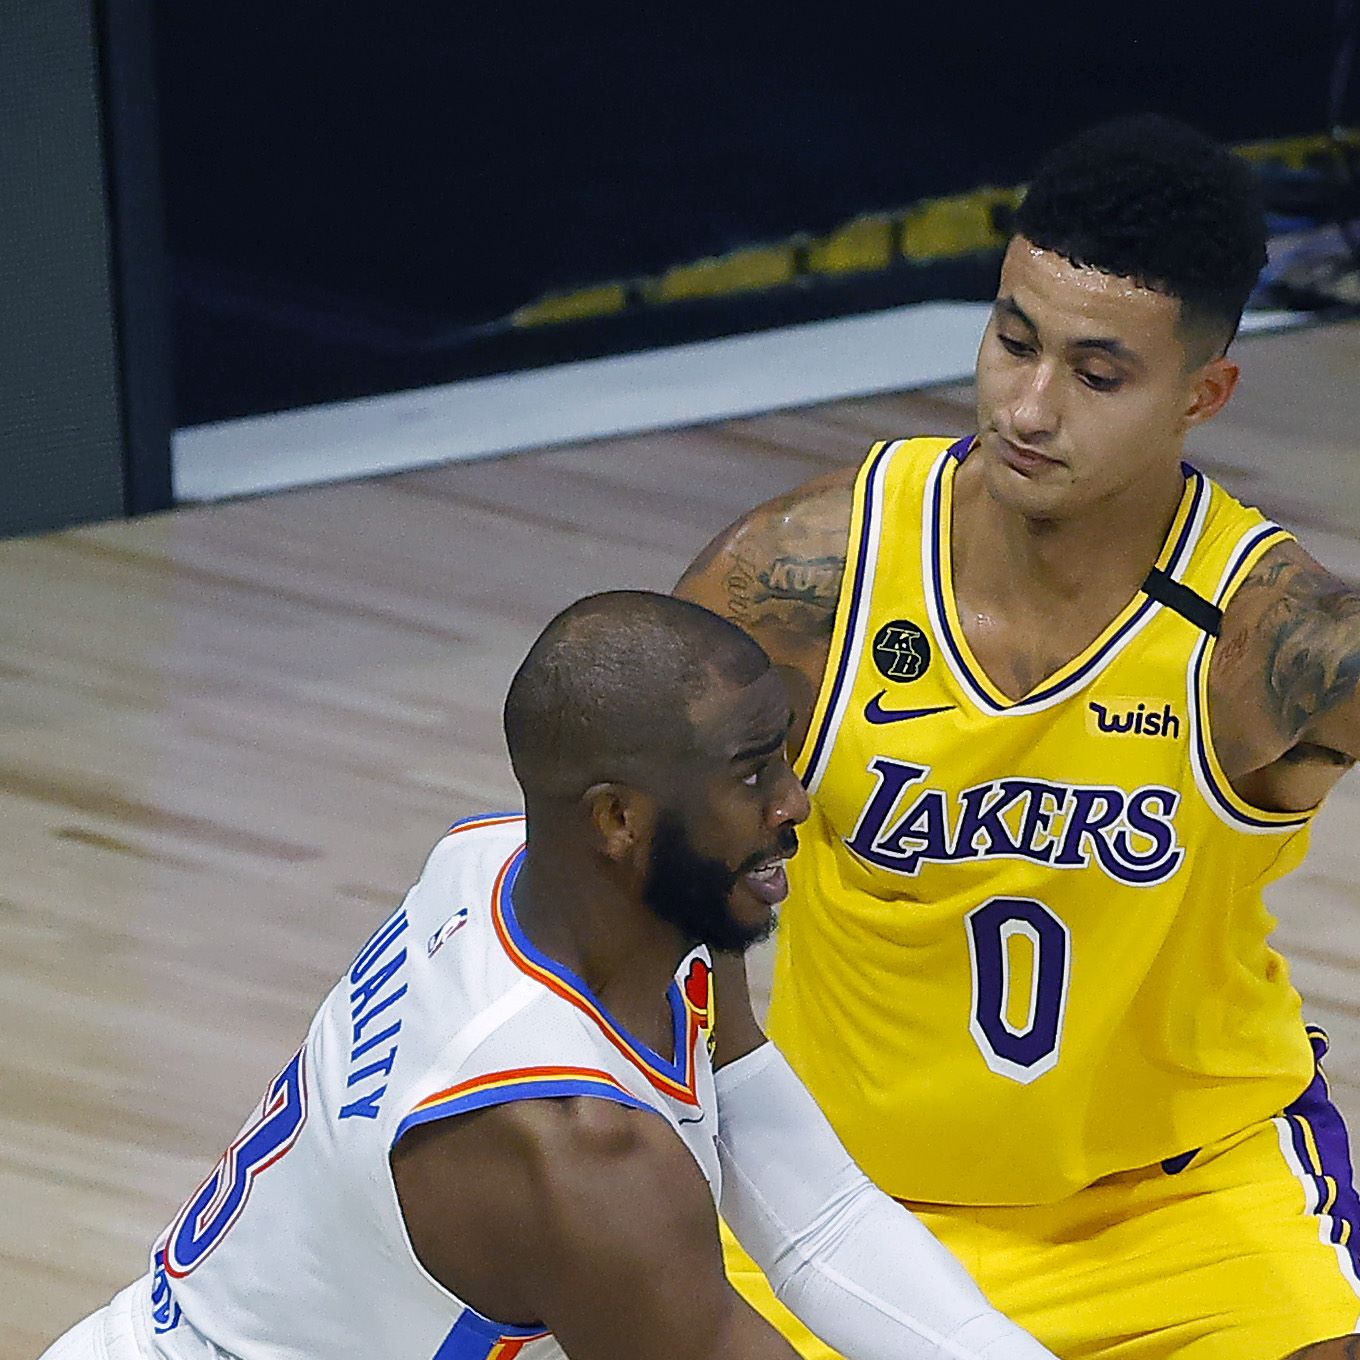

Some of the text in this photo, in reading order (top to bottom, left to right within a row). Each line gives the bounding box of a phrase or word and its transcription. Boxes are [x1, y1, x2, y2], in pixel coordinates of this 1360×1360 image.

[1090, 701, 1180, 740] wish
[843, 755, 1185, 888] LAKERS
[964, 896, 1072, 1085] 0
